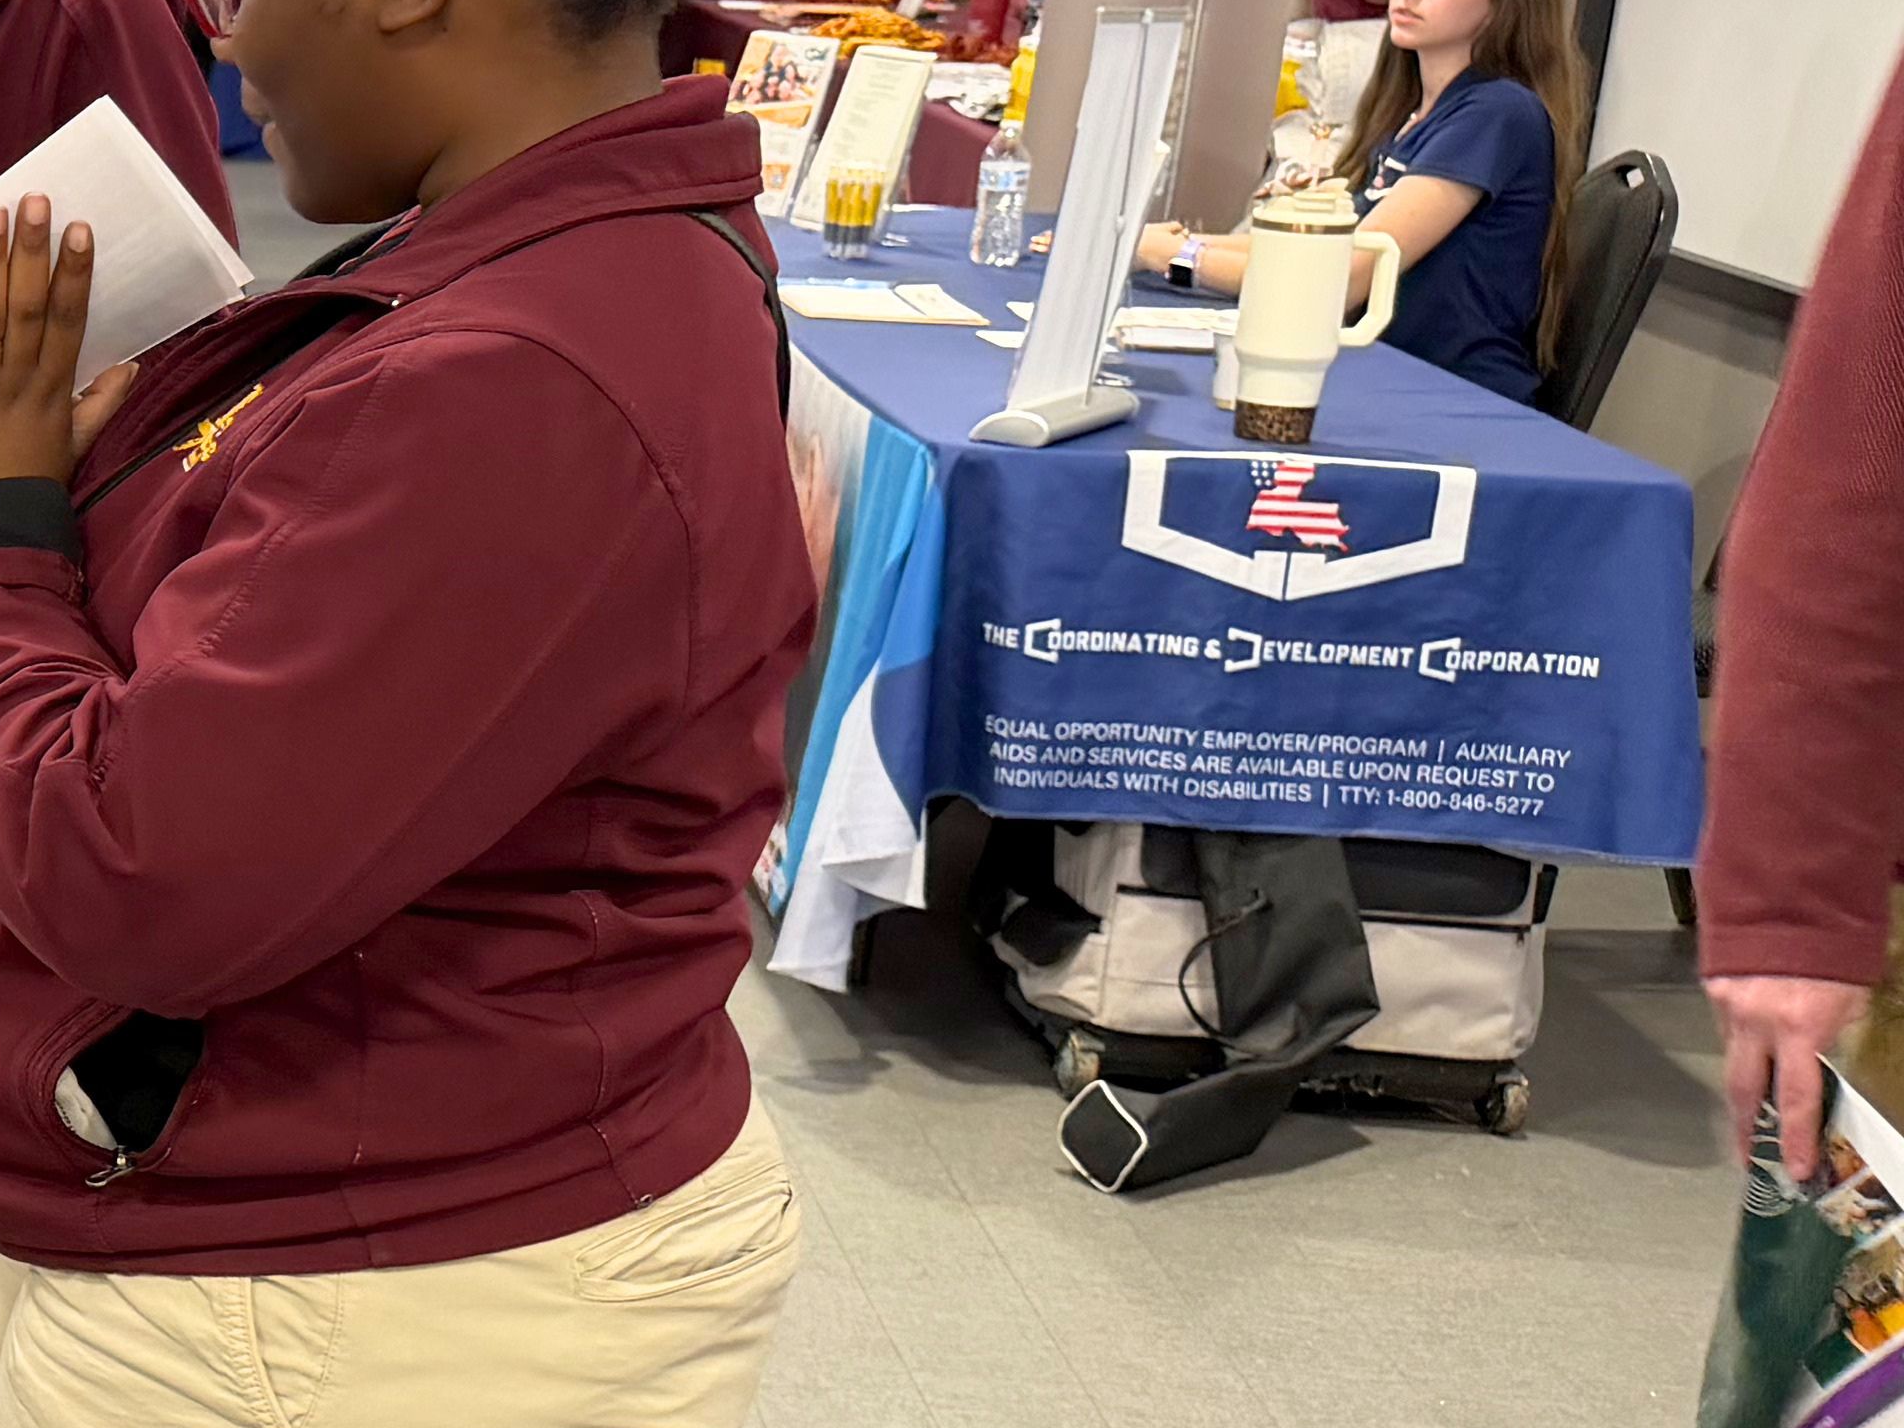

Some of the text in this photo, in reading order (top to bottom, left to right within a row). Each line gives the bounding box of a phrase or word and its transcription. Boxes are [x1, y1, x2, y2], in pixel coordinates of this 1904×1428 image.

[982, 618, 1600, 683] THE COORDINATING & DEVELOPMENT CORPORATION
[985, 715, 1049, 740] EQUAL
[1054, 722, 1199, 747] OPPORTUNITY
[1202, 729, 1428, 759] EMPLOYER/PROGRAM
[1455, 742, 1572, 769] AUXILIARY
[989, 741, 1555, 794] AIDS AND SERVICES ARE AVAILABLE UPON REQUEST TO
[994, 767, 1119, 791] INDIVIDUALS
[1123, 772, 1179, 795] WITH
[1183, 778, 1313, 804] DISABILITIES
[1338, 784, 1381, 807] TTY:
[1386, 788, 1544, 817] 1-800-846-5277
